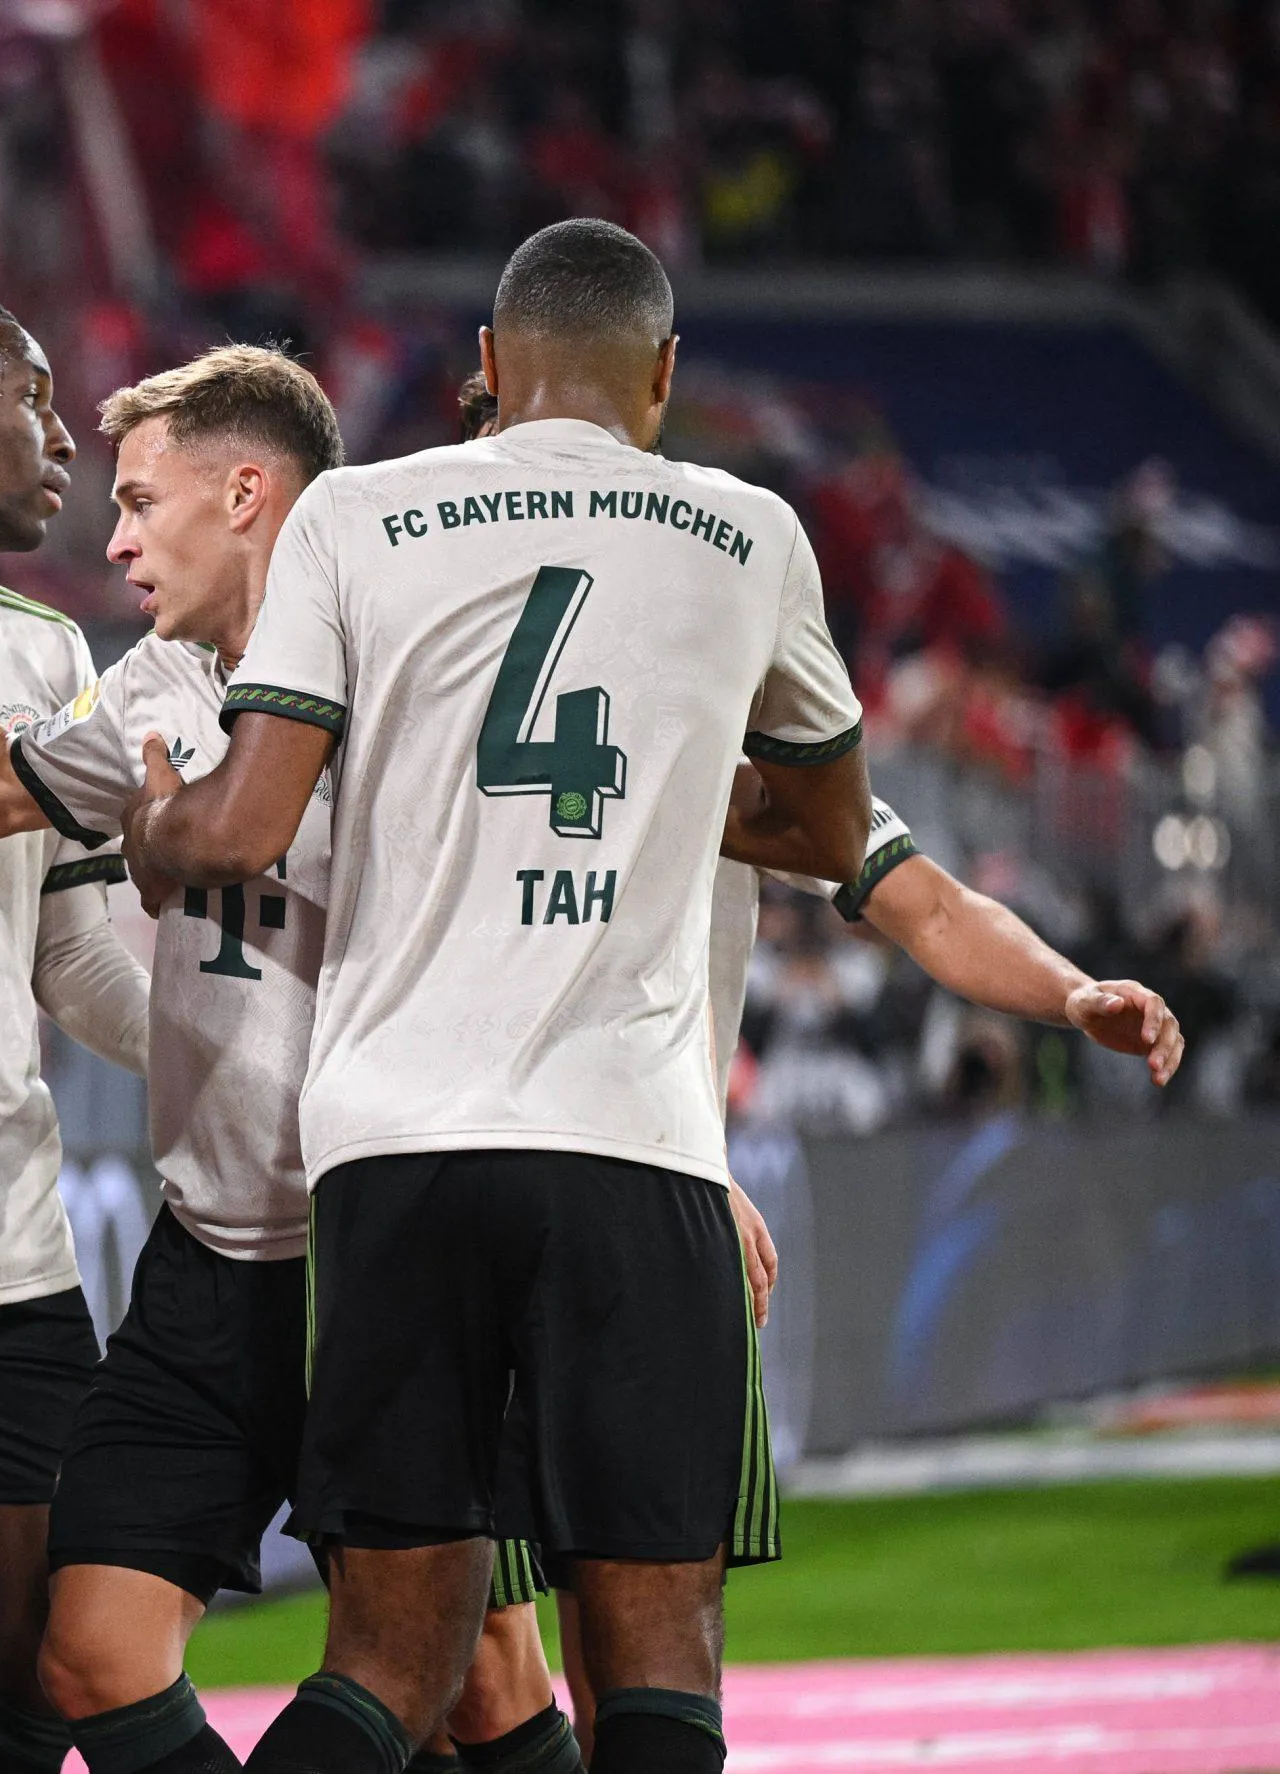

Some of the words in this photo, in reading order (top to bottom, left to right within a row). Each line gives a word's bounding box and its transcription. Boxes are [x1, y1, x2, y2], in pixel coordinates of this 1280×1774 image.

[382, 509, 428, 547] FC
[436, 490, 574, 530] BAYERN
[588, 490, 754, 567] MÜNCHEN
[476, 565, 628, 840] 4
[516, 869, 618, 926] TAH
